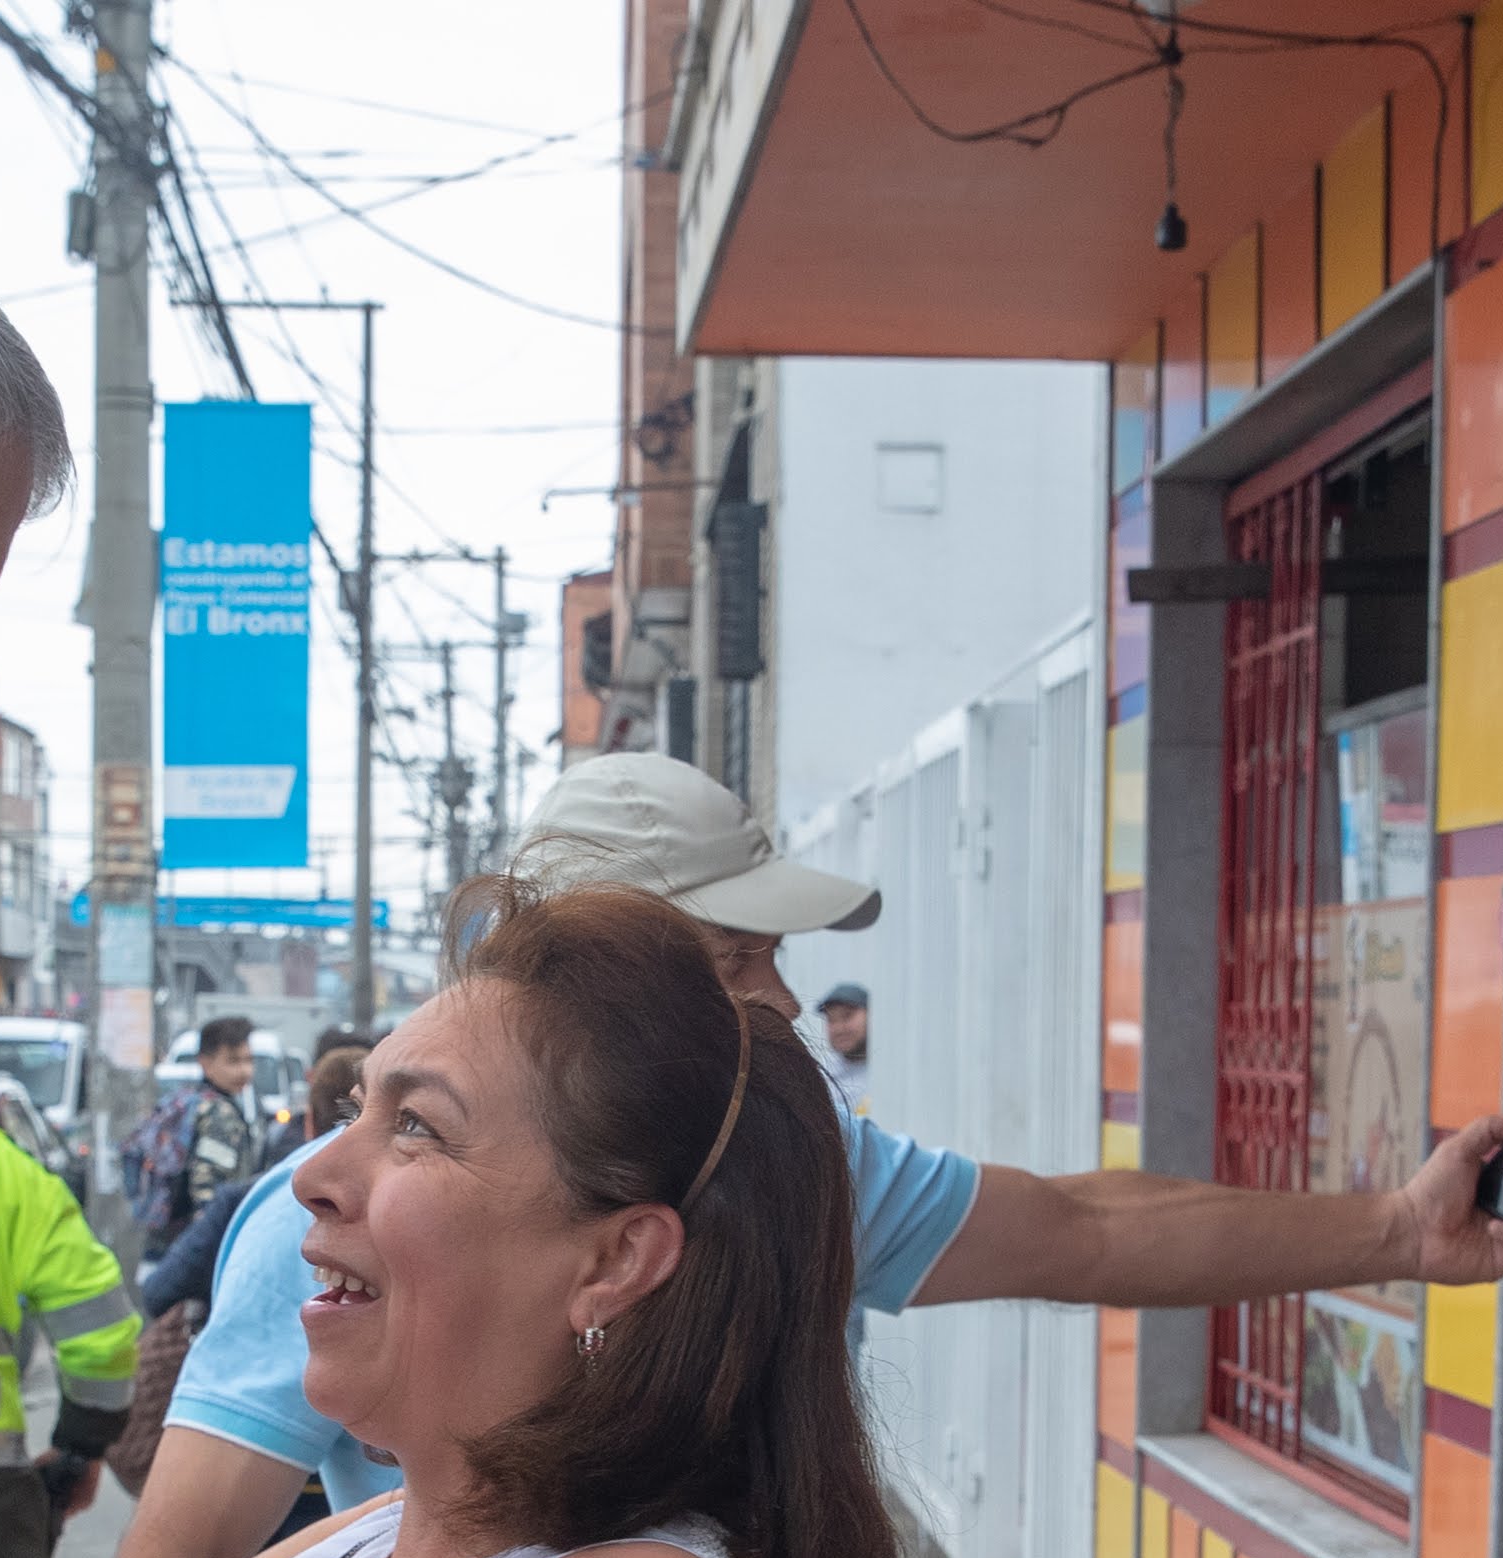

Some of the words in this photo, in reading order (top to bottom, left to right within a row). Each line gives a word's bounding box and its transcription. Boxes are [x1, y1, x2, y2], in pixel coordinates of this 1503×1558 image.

[164, 537, 307, 568] Estamos
[166, 607, 197, 635] El
[208, 607, 307, 635] Bronx
